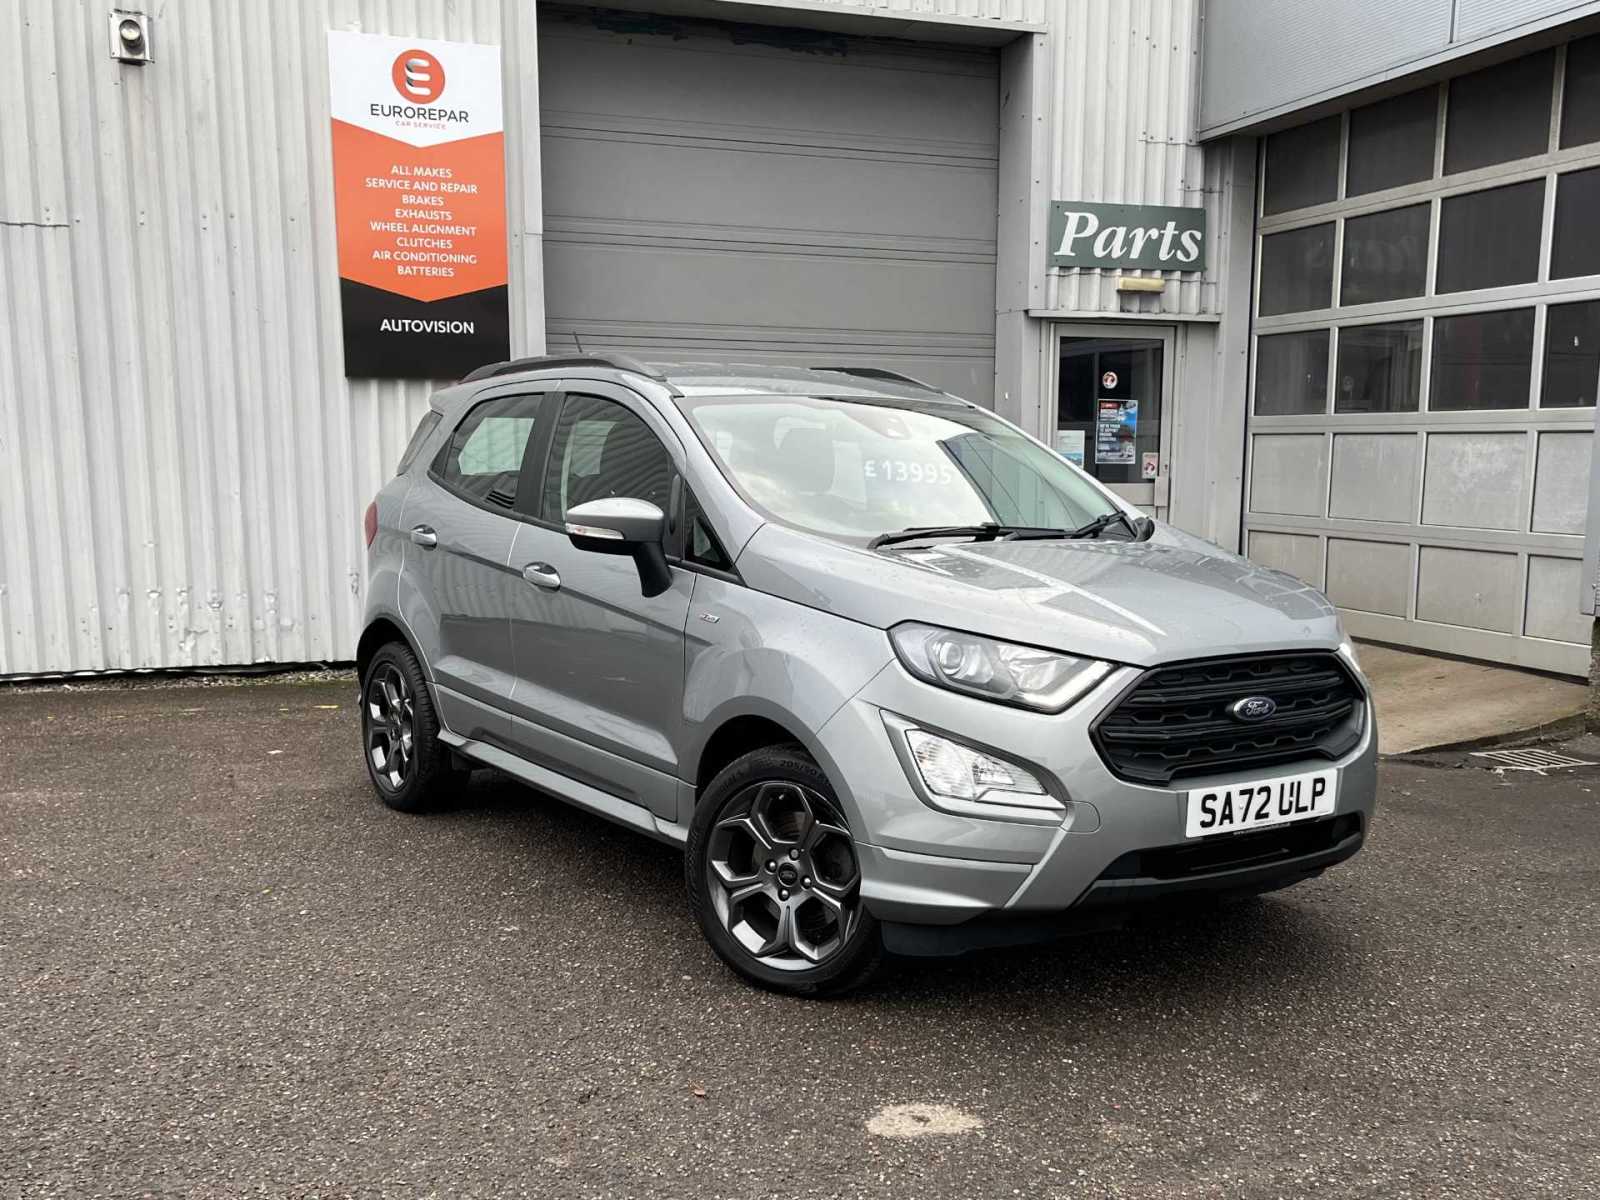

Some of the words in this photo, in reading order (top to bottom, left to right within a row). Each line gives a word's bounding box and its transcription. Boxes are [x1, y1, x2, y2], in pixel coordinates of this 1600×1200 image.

[370, 103, 469, 123] EUROREPAR
[413, 121, 447, 130] SERVICE
[391, 165, 411, 176] ALL
[413, 167, 453, 178] MAKES
[366, 178, 410, 190] SERVICE
[413, 181, 438, 191] AND
[441, 182, 478, 193] REPAIR
[402, 194, 444, 206] BRAKES
[395, 208, 452, 221] EXHAUSTS
[370, 221, 409, 233] WHEEL
[412, 224, 477, 237] ALIGNMENT
[396, 237, 453, 249] CLUTCHES
[1053, 211, 1202, 262] Parts
[372, 250, 393, 260] AIR
[393, 250, 477, 264] CONDITIONING
[397, 265, 454, 277] BATTERIES
[380, 318, 475, 334] AUTOVISION
[1246, 700, 1269, 715] Ford
[1200, 785, 1271, 828] SA72
[1278, 777, 1326, 816] ULP
